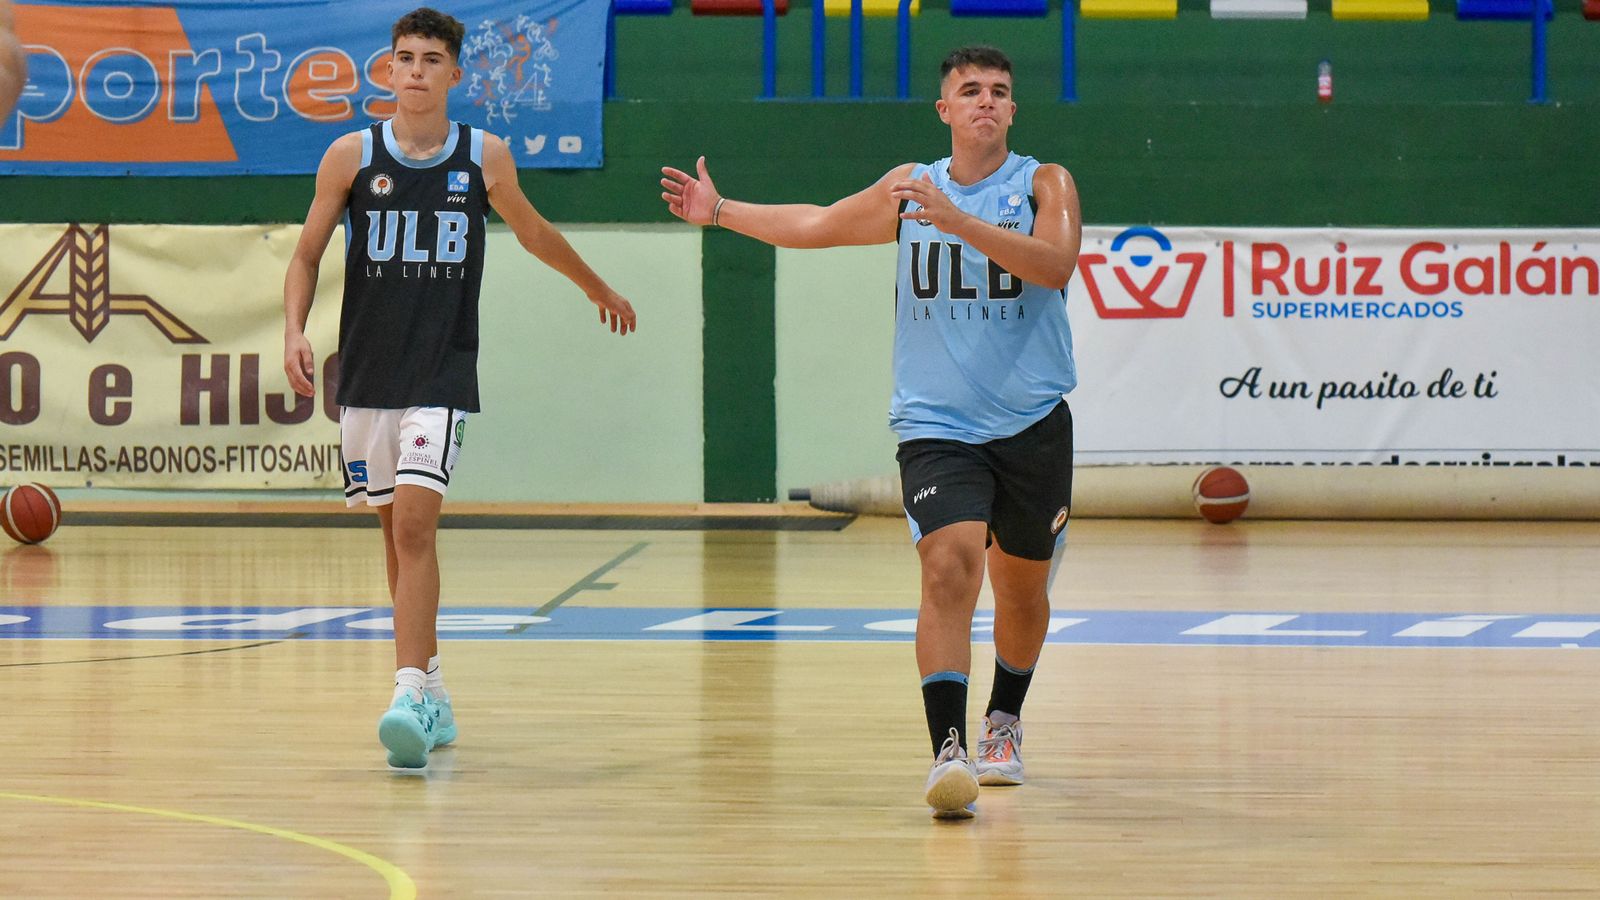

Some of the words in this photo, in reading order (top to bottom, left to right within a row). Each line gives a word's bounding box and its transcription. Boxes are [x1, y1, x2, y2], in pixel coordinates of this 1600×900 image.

[366, 210, 469, 263] ULB
[366, 264, 383, 278] LA
[402, 263, 466, 280] LÍNEA
[910, 240, 1024, 301] ULB
[1251, 241, 1384, 296] Ruiz
[1399, 241, 1600, 296] Galán
[913, 305, 932, 321] LA
[950, 302, 1025, 320] LÍNEA
[1252, 301, 1464, 319] SUPERMERCADOS
[88, 363, 133, 427] e
[1219, 367, 1262, 399] A
[1268, 380, 1313, 399] un
[1316, 371, 1421, 411] pasito
[1427, 368, 1468, 399] de
[1473, 371, 1499, 399] ti
